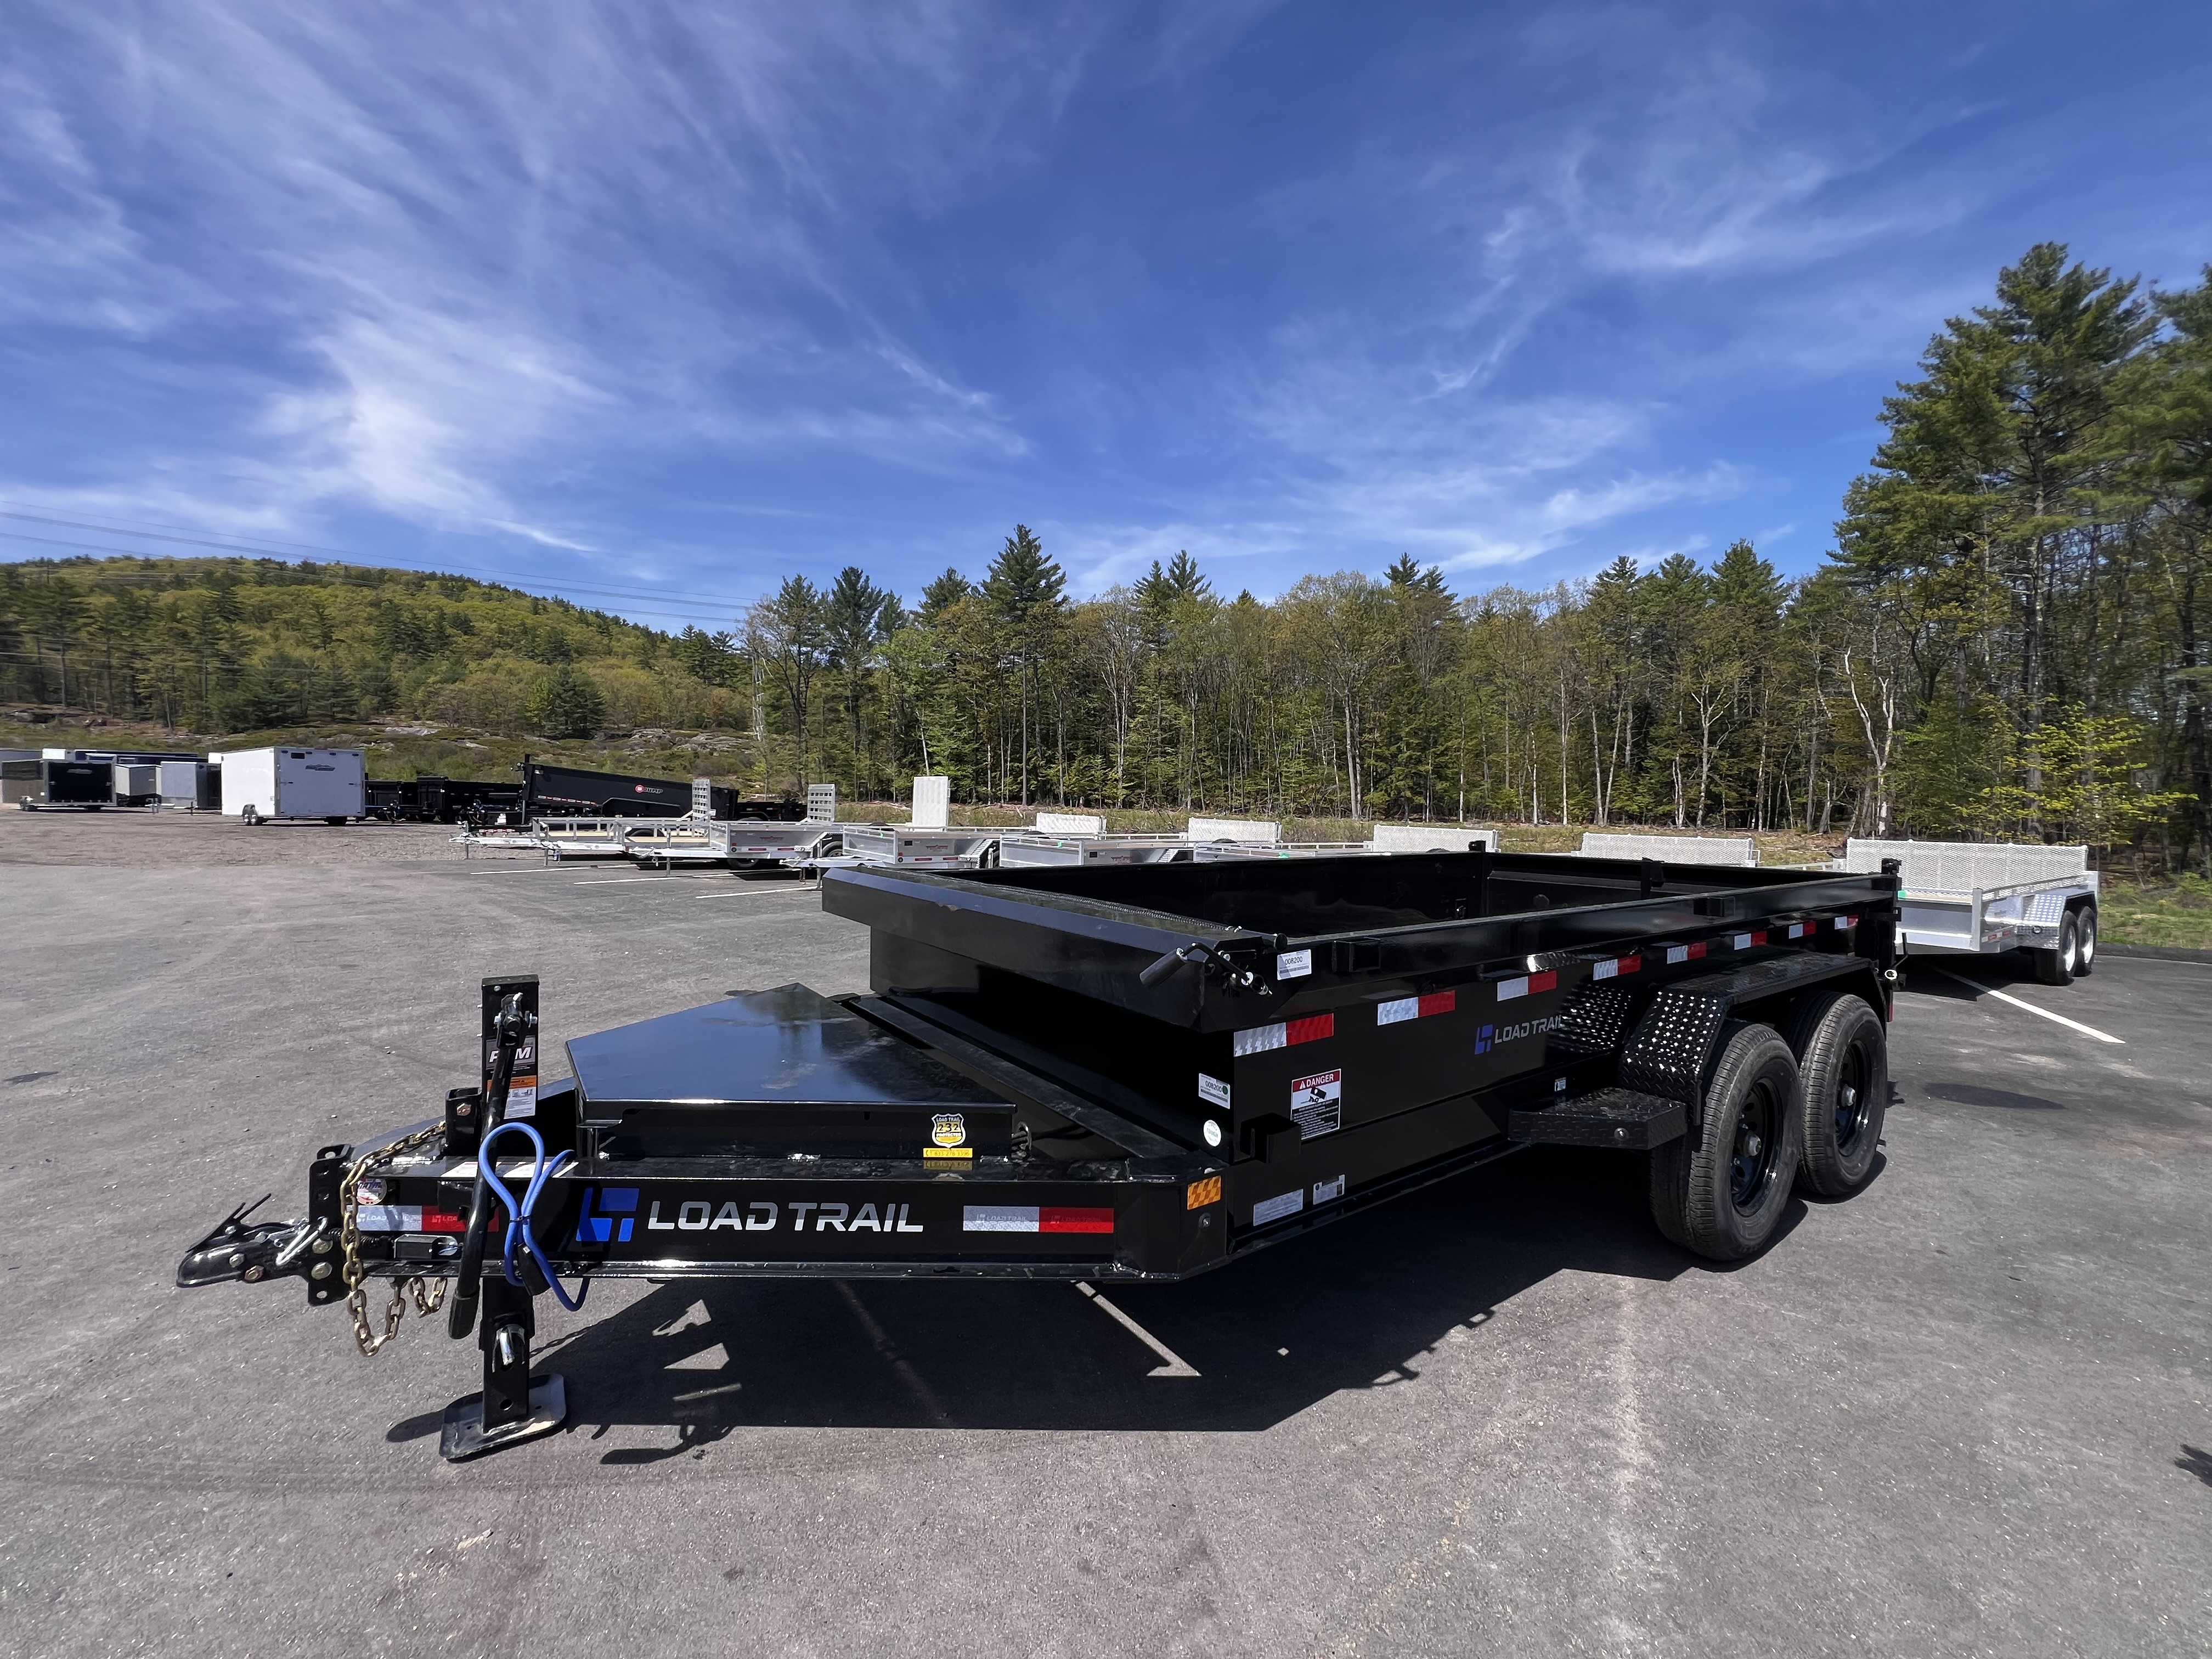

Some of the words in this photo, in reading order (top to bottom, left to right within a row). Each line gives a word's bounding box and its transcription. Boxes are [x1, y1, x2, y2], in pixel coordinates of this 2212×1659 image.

[1284, 956, 1303, 965] 008200
[1494, 1022, 1530, 1044] LOAD
[1532, 1015, 1563, 1035] TRAIL
[489, 1047, 532, 1063] RM
[1306, 1074, 1334, 1087] DANGER
[938, 1122, 959, 1132] 232
[648, 1201, 778, 1230] LOAD
[788, 1203, 924, 1232] TRAIL
